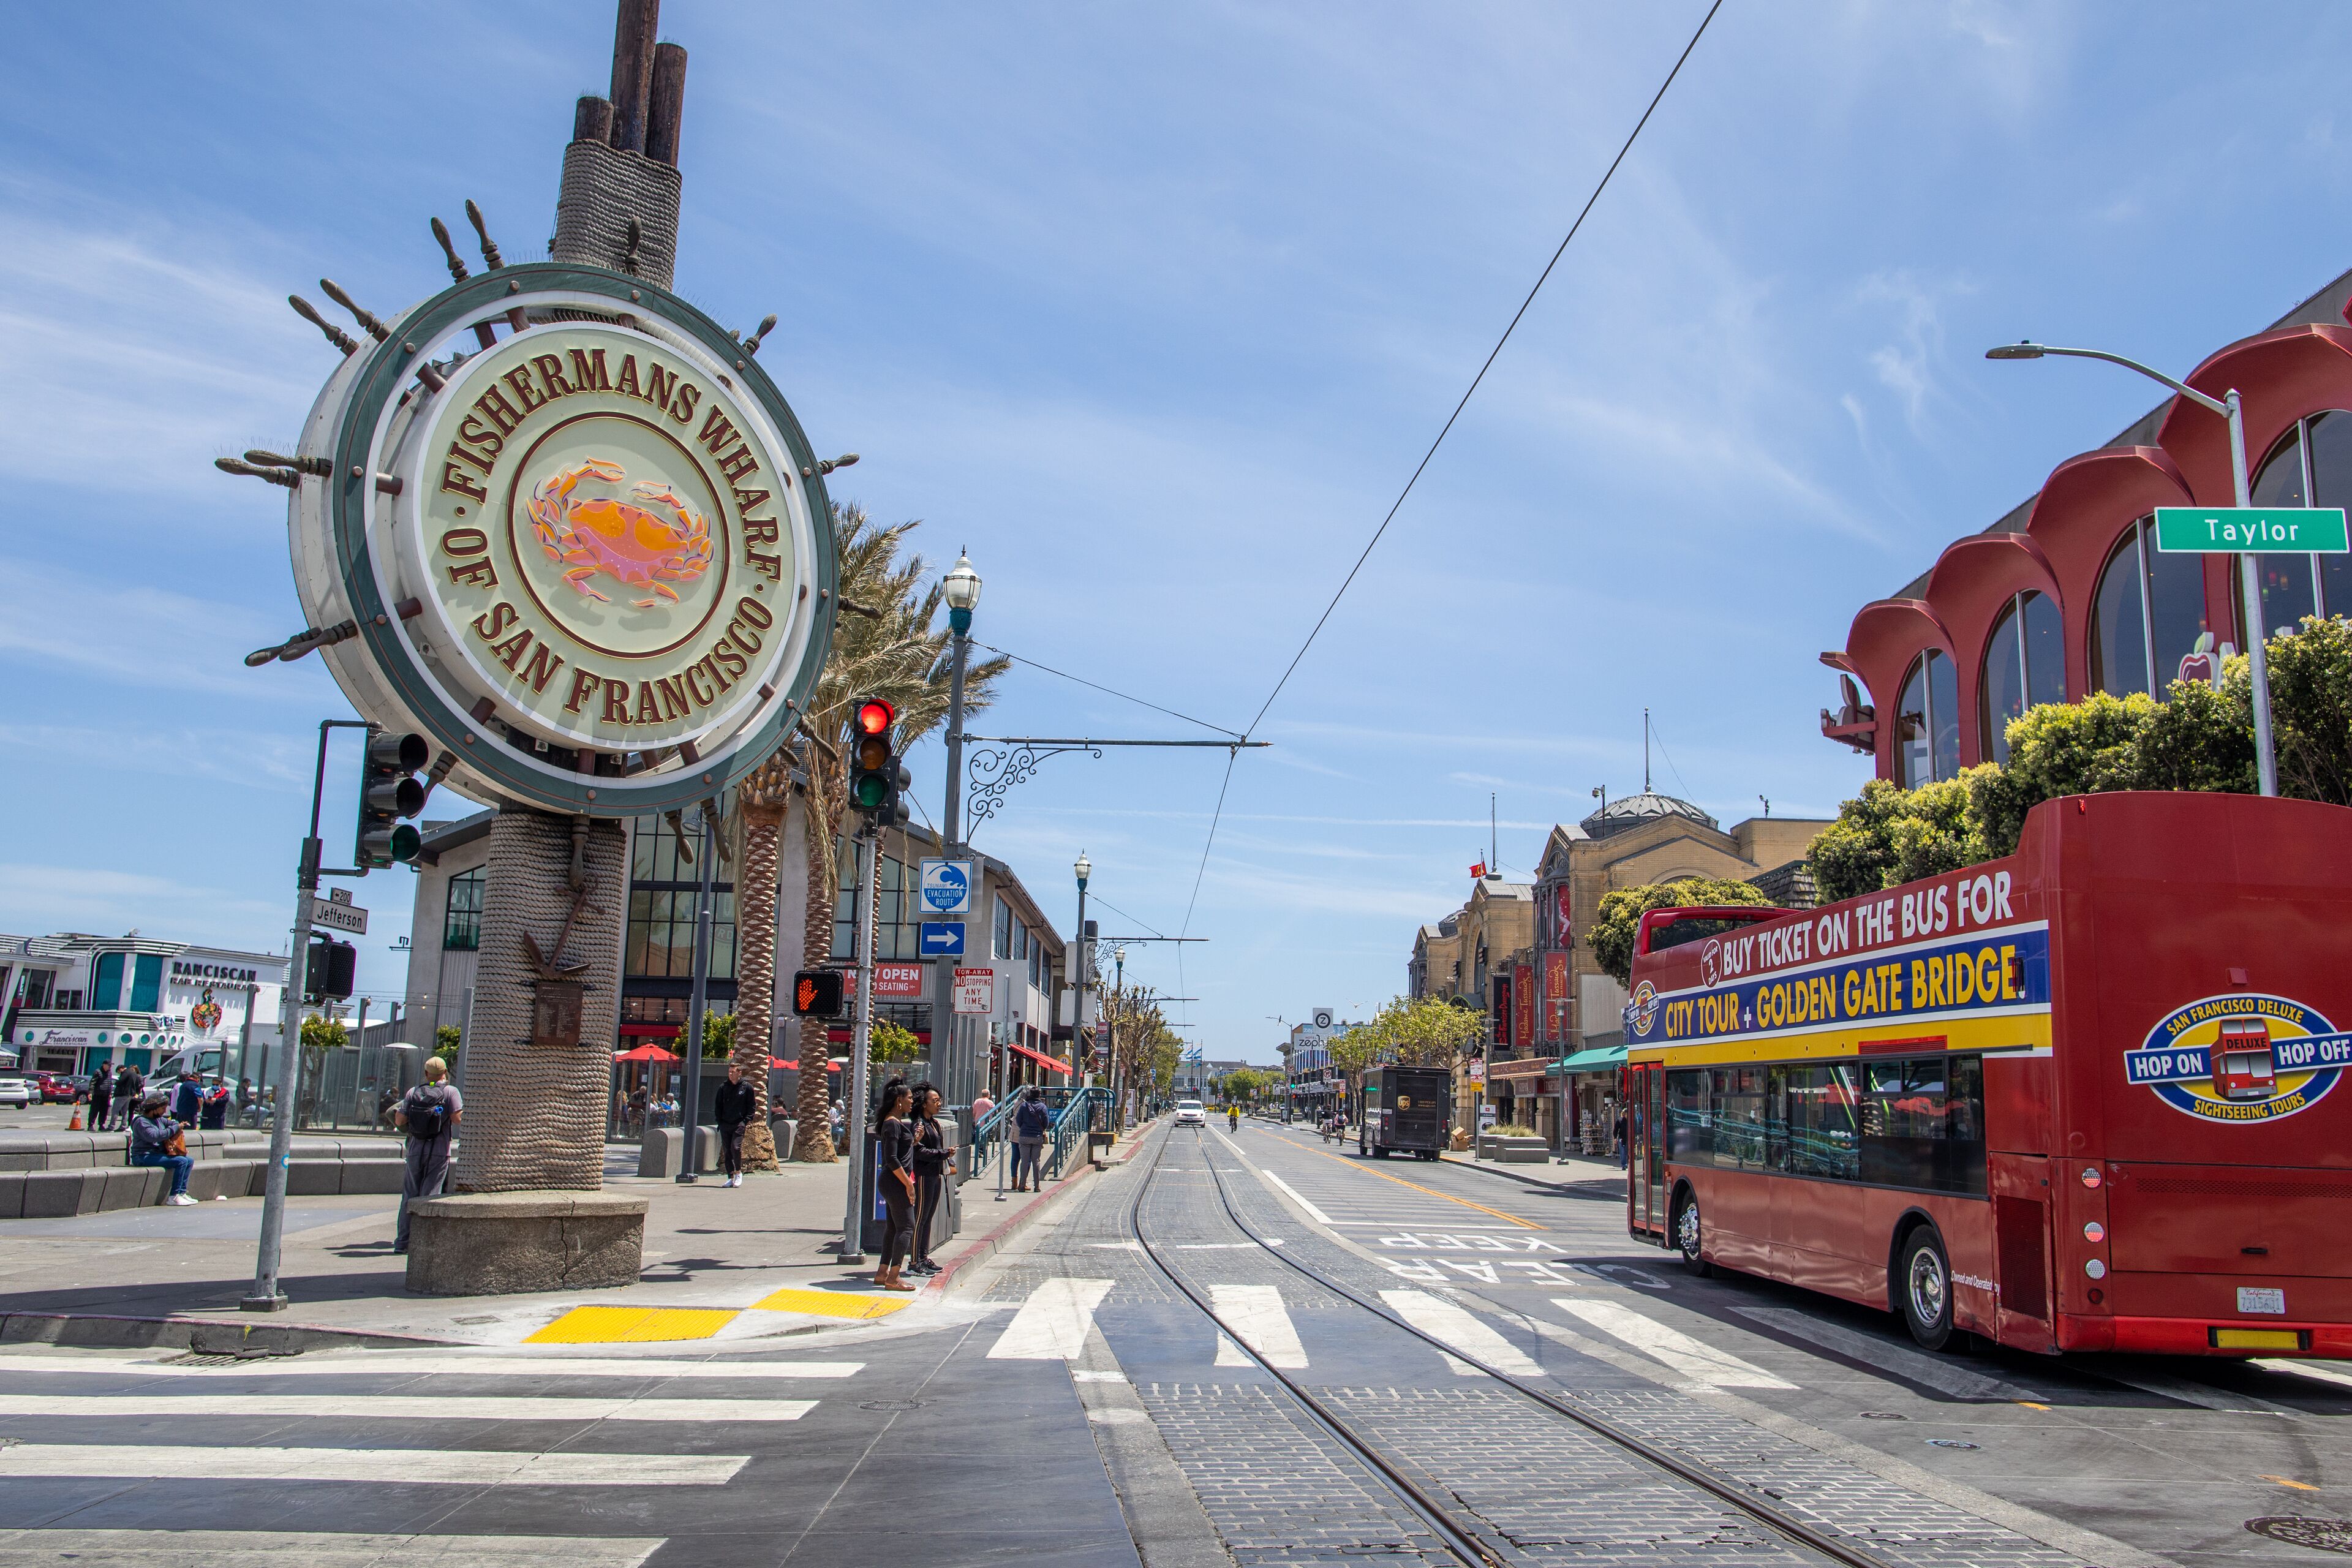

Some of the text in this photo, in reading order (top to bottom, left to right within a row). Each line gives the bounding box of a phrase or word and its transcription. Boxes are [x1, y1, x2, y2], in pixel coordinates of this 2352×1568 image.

[442, 347, 783, 582] FISHERMANS WHARF
[2205, 519, 2298, 545] Taylor
[442, 527, 774, 725] OF SAN FRANCISCO
[339, 891, 350, 903] 200
[317, 905, 362, 928] Jefferson
[1724, 870, 2014, 976] BUY TICKET ON THE BUS FOR
[1703, 952, 1712, 963] VALID
[1709, 959, 1714, 974] 2
[172, 961, 257, 982] RANCISCAN
[883, 968, 919, 980] OPEN
[956, 976, 965, 986] NO
[1549, 964, 1564, 1000] Tussauds
[1708, 971, 1717, 986] DAYS
[195, 979, 249, 991] RESTAURA
[879, 982, 908, 991] SEATING
[1665, 945, 2016, 1038] CITY TOUR + GOLDEN GATE BRIDGE
[1518, 976, 1531, 1039] Madame Tussauds
[2166, 999, 2304, 1036] SAN FRANCISCO DELUXE
[39, 1030, 87, 1045] Franciscan
[2226, 1038, 2266, 1049] DELUXE
[2135, 1039, 2351, 1077] HOP ON HOP OFF
[2193, 1092, 2306, 1119] SIGHTSEEING TOURS
[1378, 1232, 1569, 1253] KEEP
[1376, 1256, 1671, 1289] CLEAR
[1951, 1270, 1965, 1284] Owned
[1973, 1275, 1992, 1291] Operated
